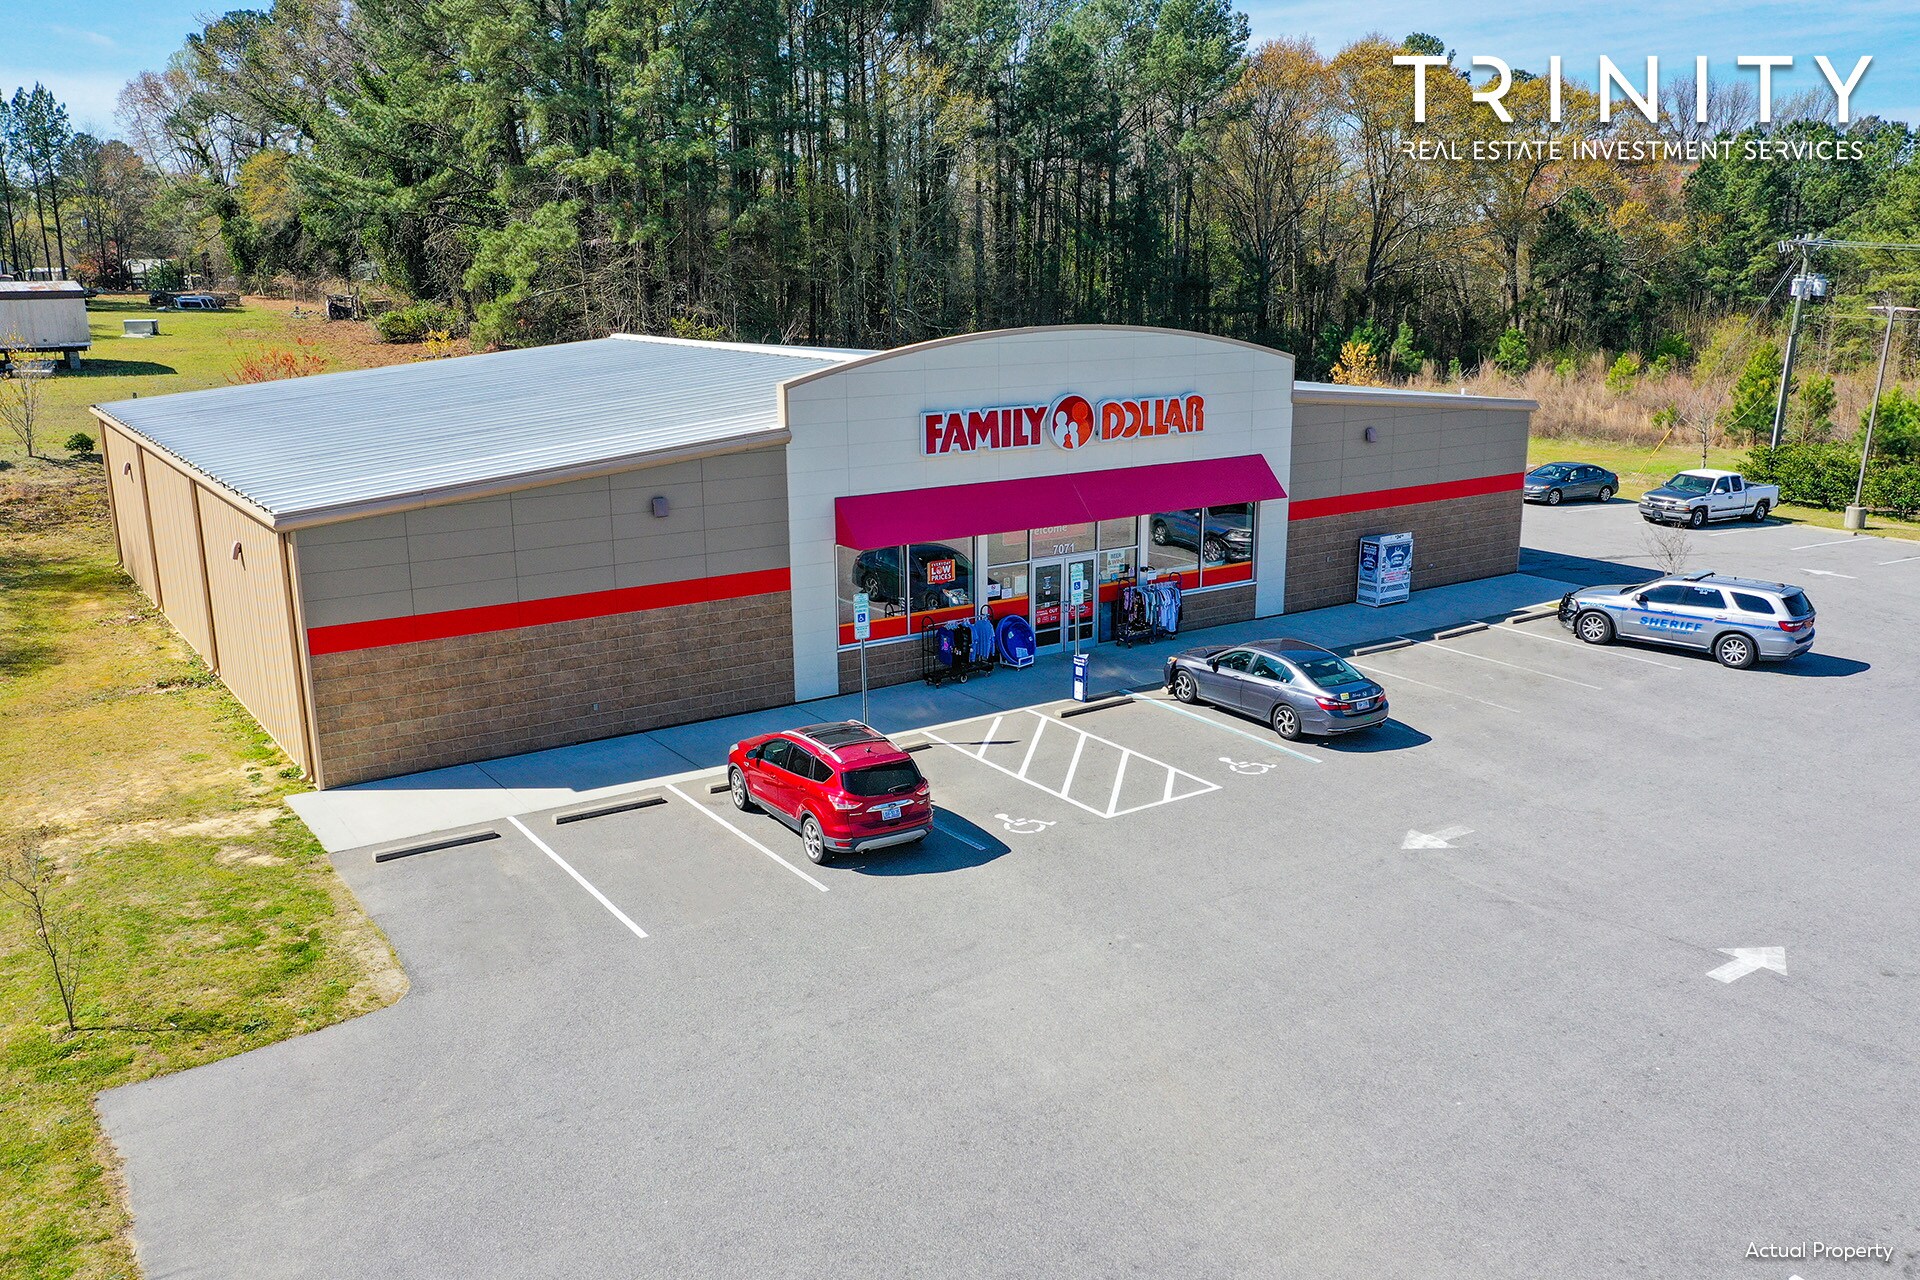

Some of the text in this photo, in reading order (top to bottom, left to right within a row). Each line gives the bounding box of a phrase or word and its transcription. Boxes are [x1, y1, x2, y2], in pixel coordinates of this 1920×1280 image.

[923, 393, 1205, 455] FAMILY DOLLAR
[1025, 524, 1068, 535] elcome
[1053, 543, 1075, 555] 7071
[931, 565, 951, 575] LOW
[931, 573, 952, 581] PRICES
[1640, 616, 1703, 631] SHERIFF
